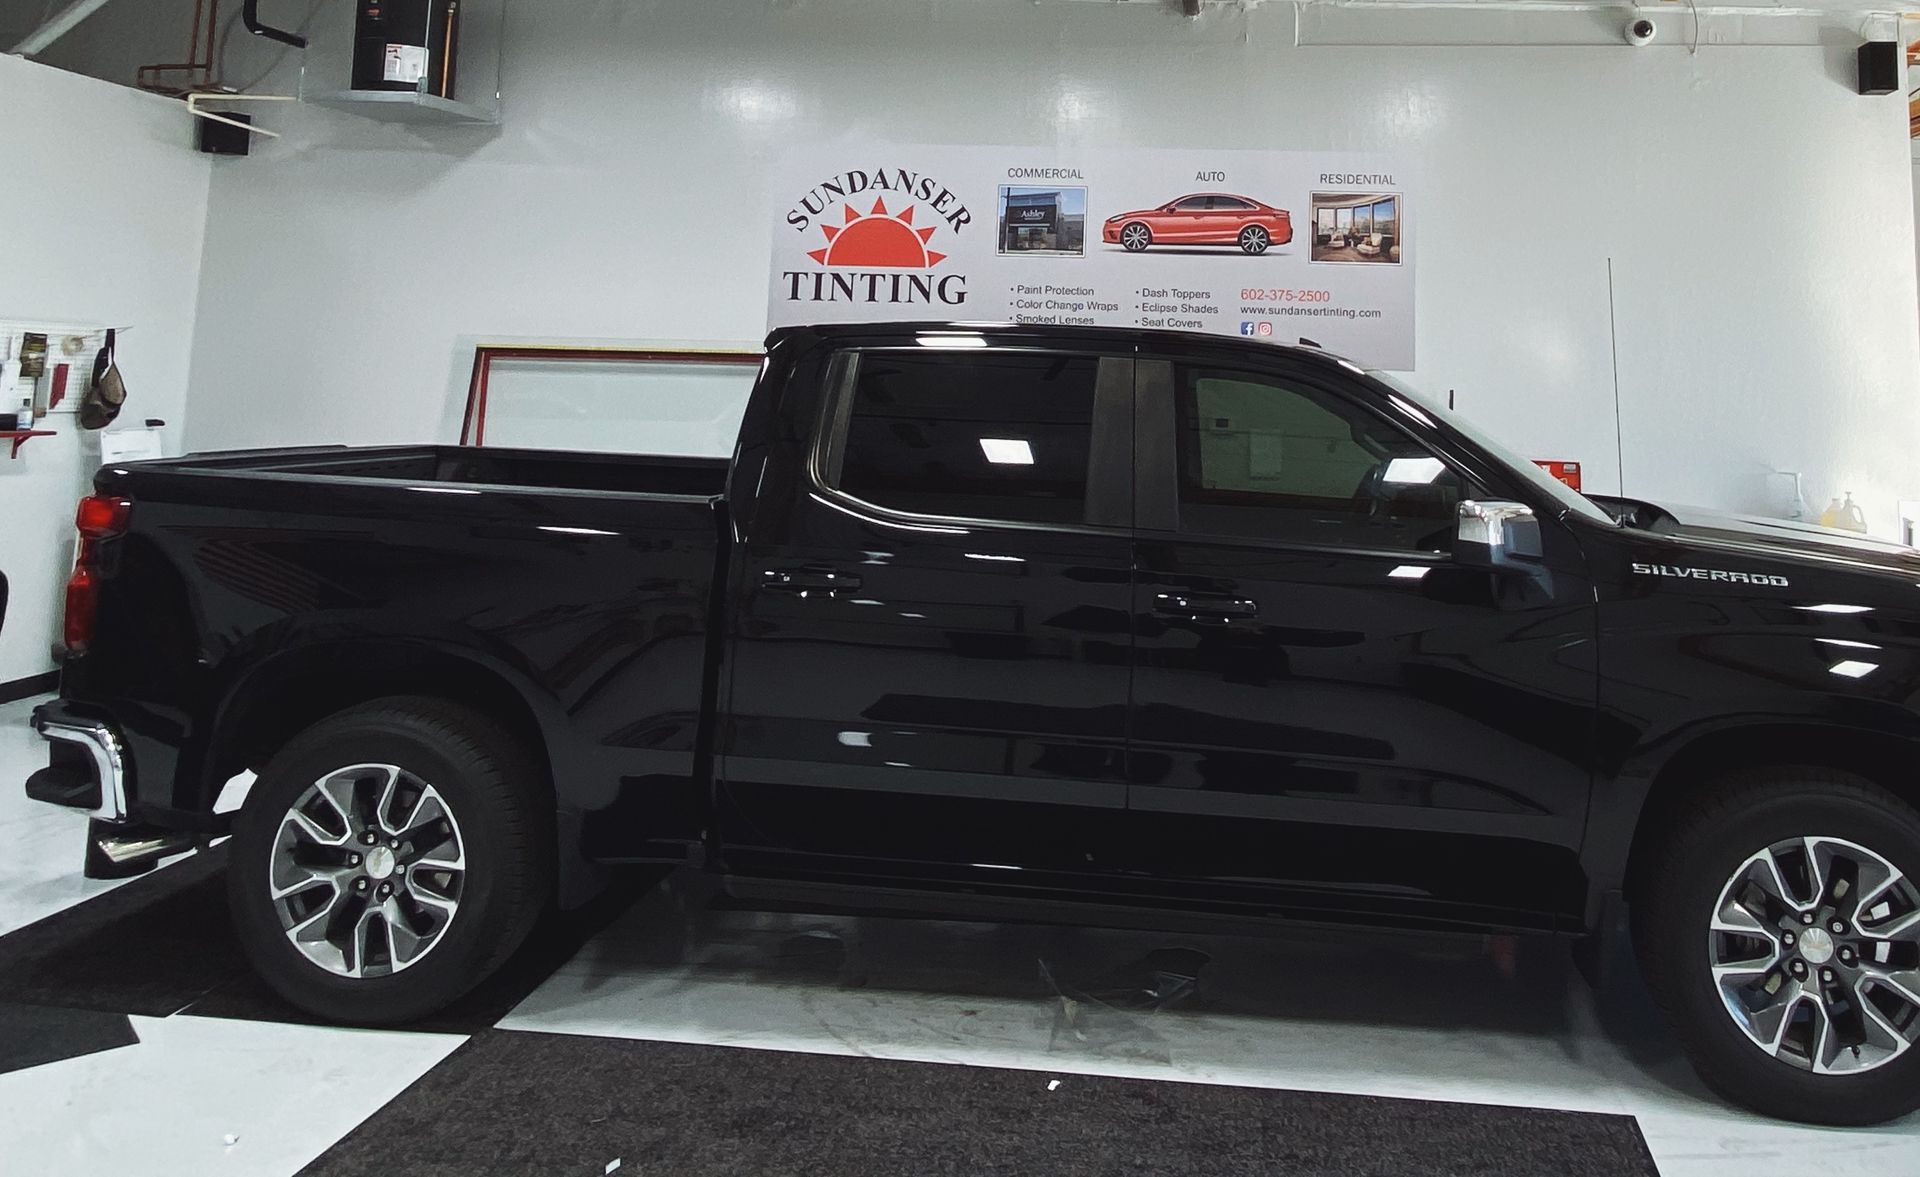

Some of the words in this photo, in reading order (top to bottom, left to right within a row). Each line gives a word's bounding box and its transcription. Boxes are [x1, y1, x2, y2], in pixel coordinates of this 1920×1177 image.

[1007, 167, 1084, 180] COMMERCIAL
[1195, 171, 1226, 183] AUTO
[1319, 173, 1396, 186] RESIDENTIAL
[787, 168, 971, 234] SUNDANSER
[1020, 209, 1045, 218] Ashley
[783, 271, 968, 305] TINTING
[1017, 284, 1042, 295] Paint
[1045, 285, 1095, 296] Protection
[1142, 288, 1168, 298] Dash
[1171, 288, 1211, 301] Toppers
[1240, 288, 1331, 302] 602-375-2500
[1016, 299, 1042, 309] Color
[1045, 300, 1084, 312] Change
[1086, 301, 1119, 313] Wraps
[1141, 302, 1178, 314] Eclipse
[1180, 303, 1219, 314] Shades
[1240, 305, 1382, 320] www.sundansertinting.com
[1016, 314, 1056, 324] Smoked
[1059, 315, 1095, 325] Lenses
[1141, 317, 1165, 327] Seat
[1167, 318, 1203, 328] Covers
[1632, 563, 1789, 587] SILVERADO
